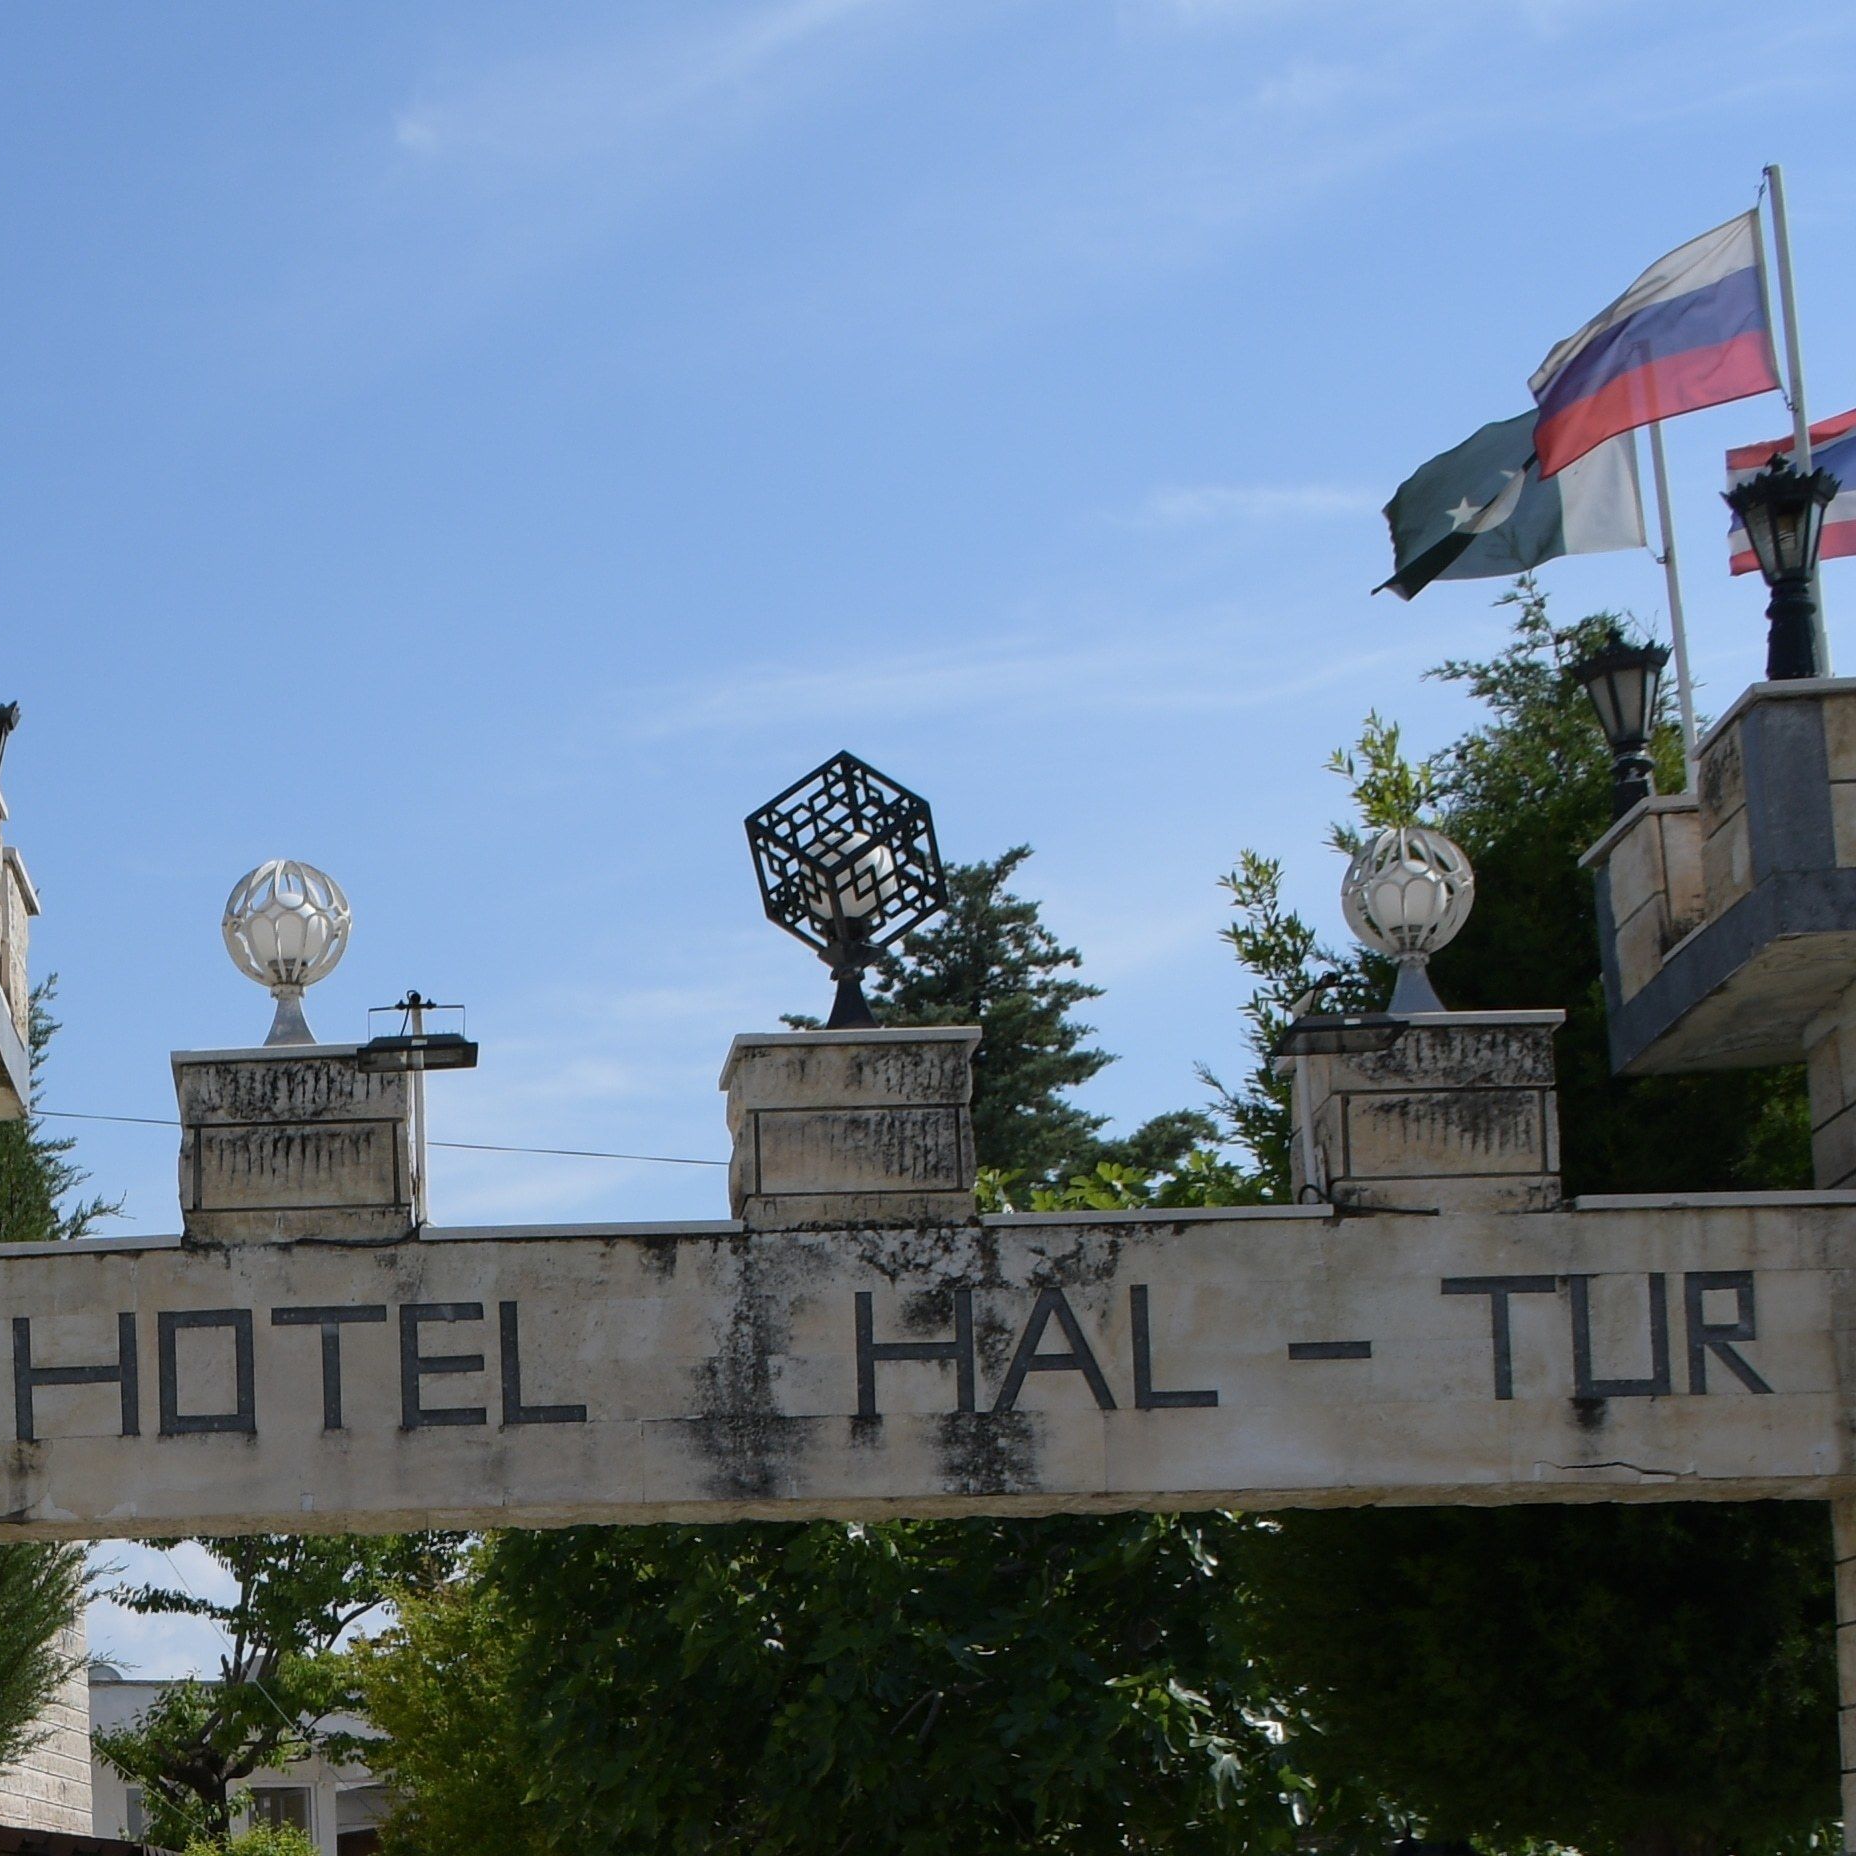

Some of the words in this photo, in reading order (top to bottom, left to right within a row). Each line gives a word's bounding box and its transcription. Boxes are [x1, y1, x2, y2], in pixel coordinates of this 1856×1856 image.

[12, 1300, 587, 1442] HOTEL
[854, 1283, 1219, 1417] HAL
[1440, 1270, 1775, 1400] TUR
